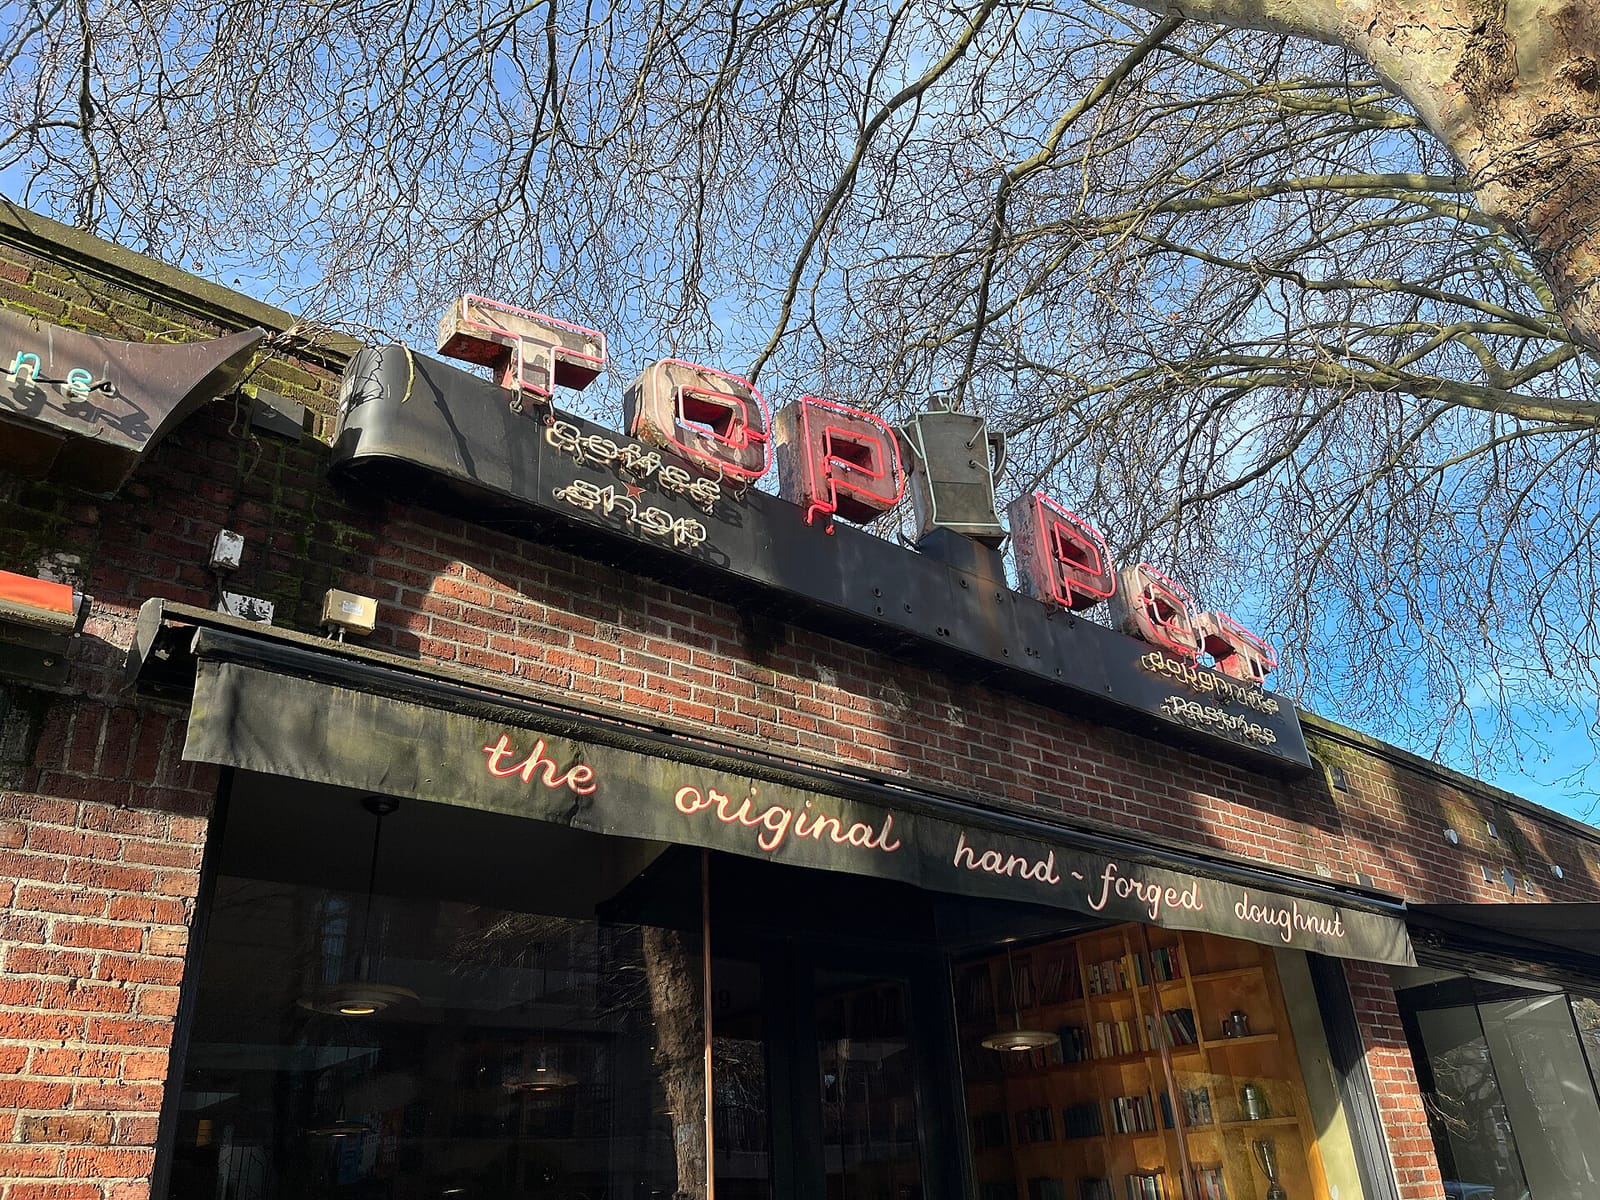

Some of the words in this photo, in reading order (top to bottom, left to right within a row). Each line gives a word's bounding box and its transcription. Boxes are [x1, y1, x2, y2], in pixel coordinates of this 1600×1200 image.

[439, 294, 905, 530] TOP
[546, 420, 721, 513] coffee
[562, 479, 706, 547] shop
[482, 733, 598, 796] the
[673, 784, 902, 852] original
[1234, 892, 1346, 943] doughnut
